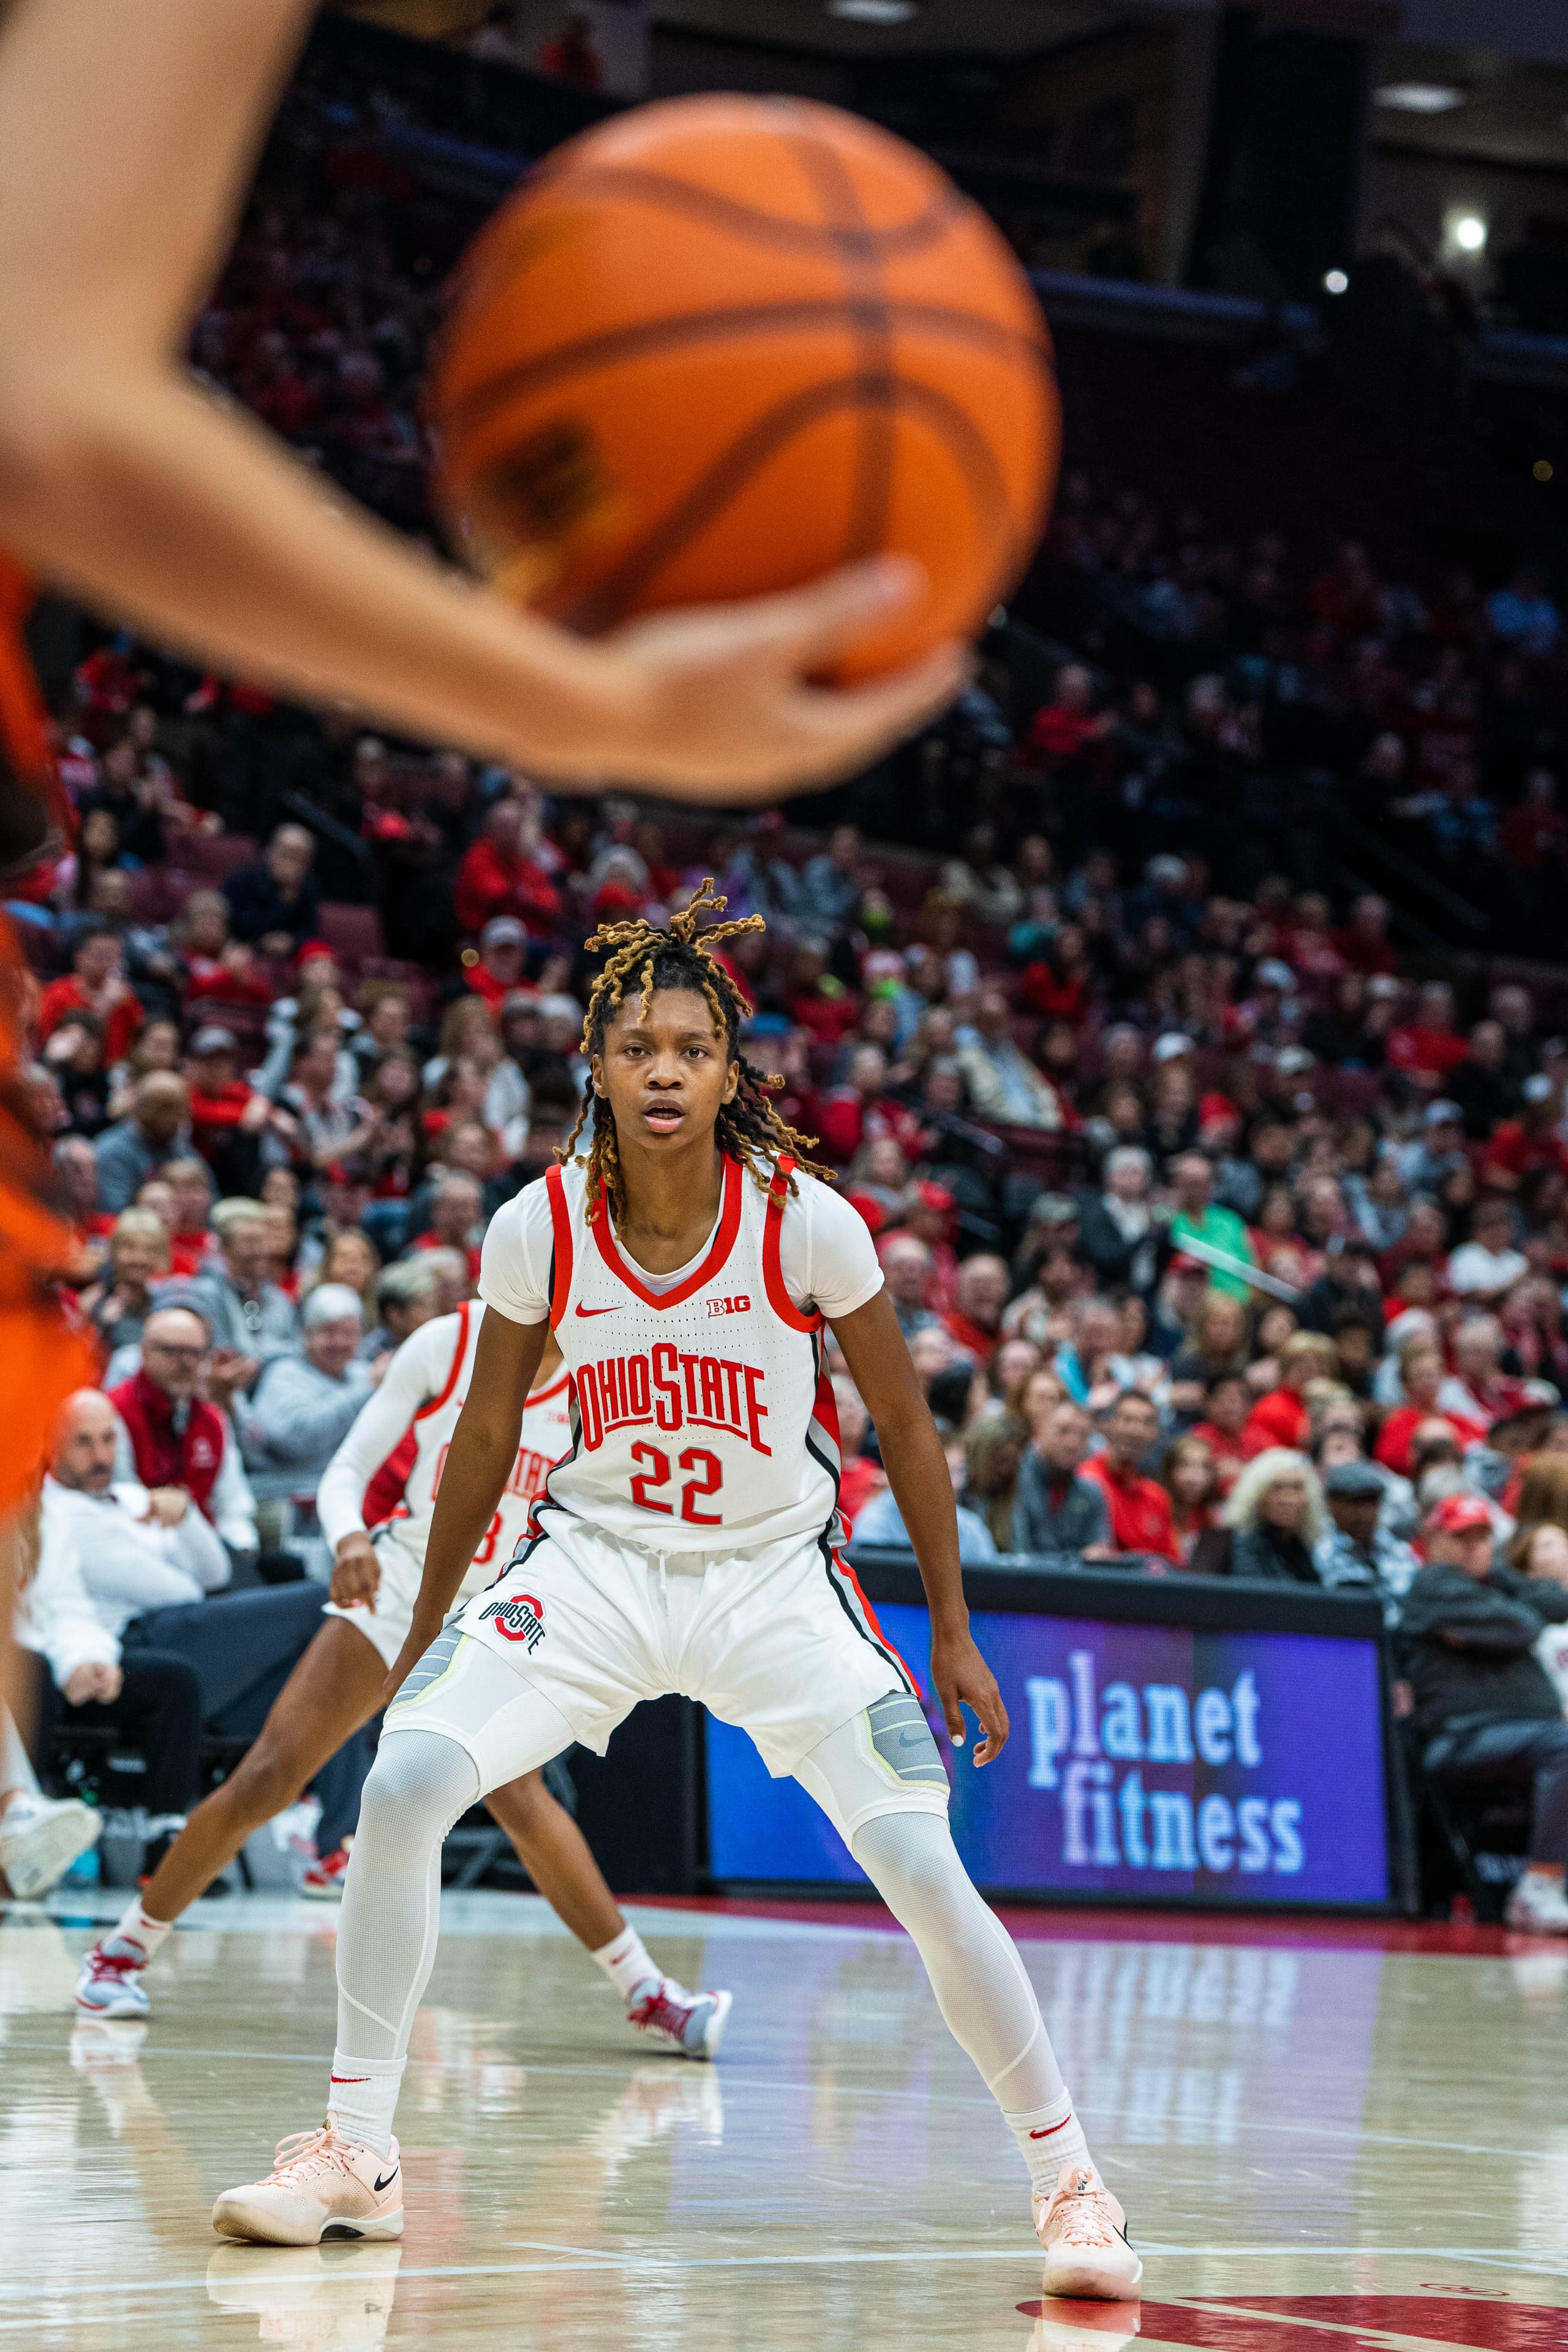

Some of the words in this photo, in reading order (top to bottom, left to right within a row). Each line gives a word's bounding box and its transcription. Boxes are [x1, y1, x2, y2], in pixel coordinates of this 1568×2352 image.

[629, 1439, 723, 1525] 22
[1025, 1649, 1262, 1790] planet
[1060, 1760, 1306, 1875] fitness
